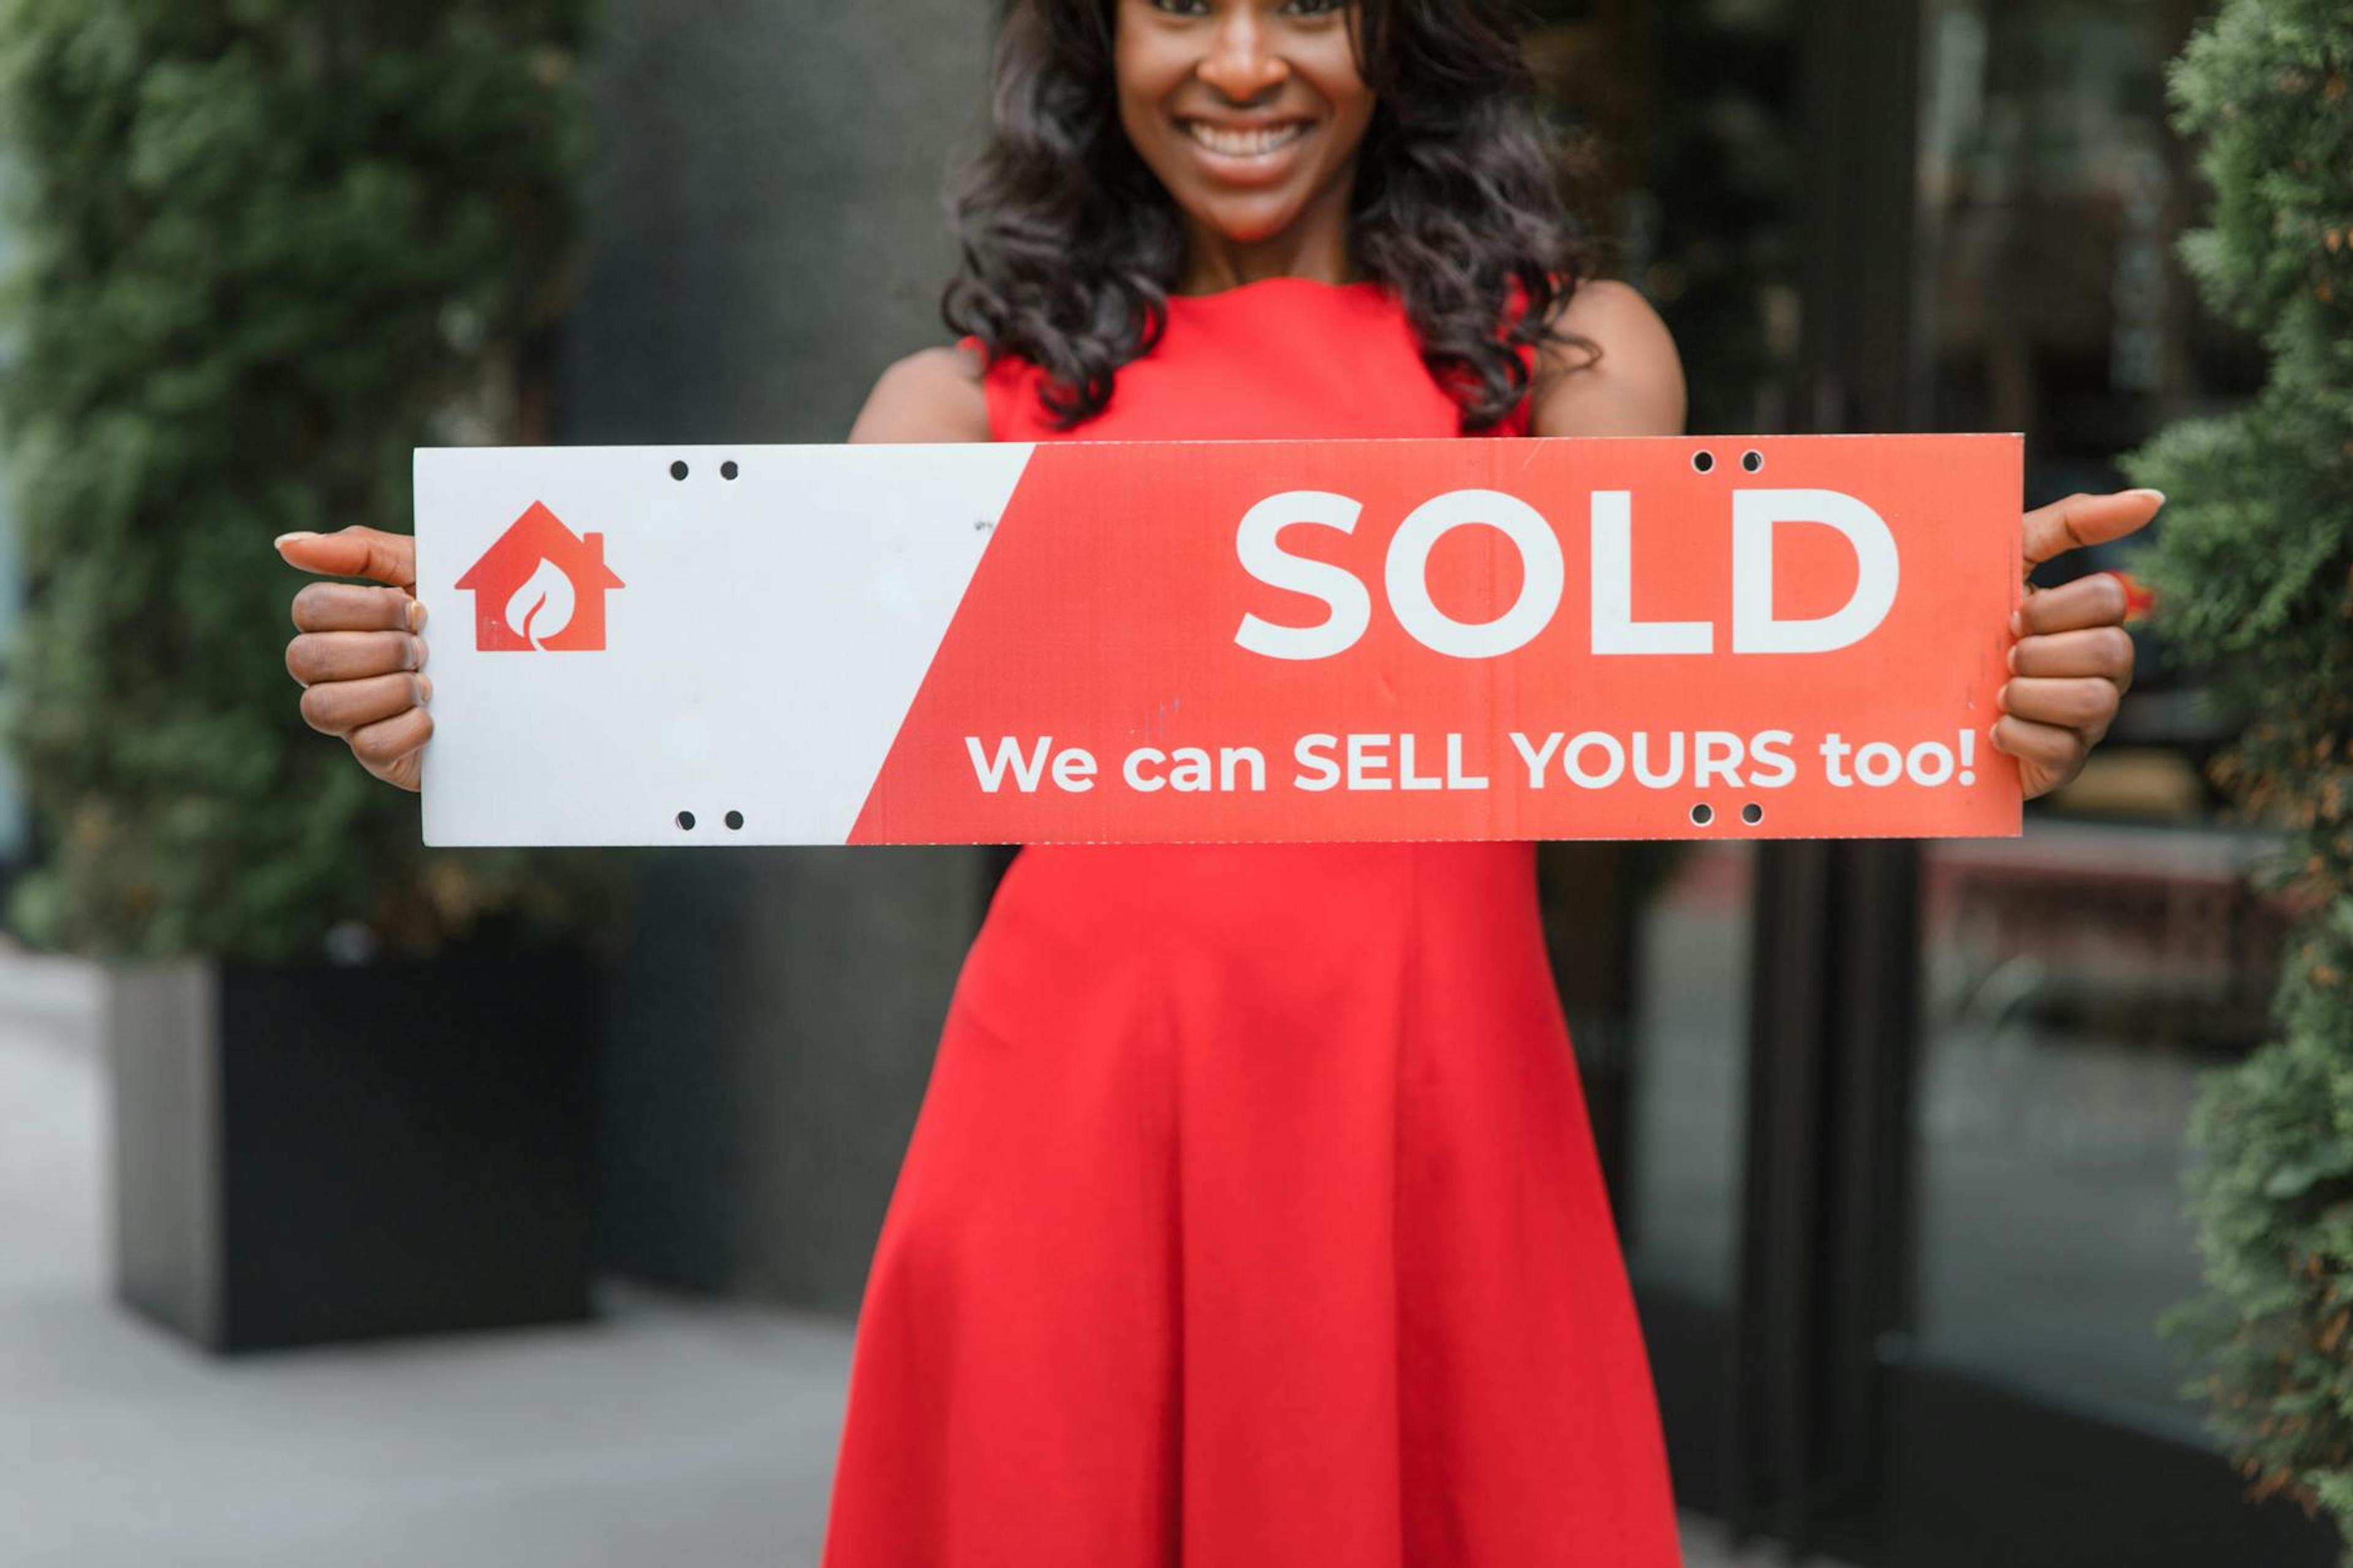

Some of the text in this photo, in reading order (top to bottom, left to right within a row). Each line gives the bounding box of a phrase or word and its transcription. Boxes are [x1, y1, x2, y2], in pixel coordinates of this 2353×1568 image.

[1234, 488, 1900, 660] SOLD
[964, 729, 1976, 793] We can SELL YOURS too!
